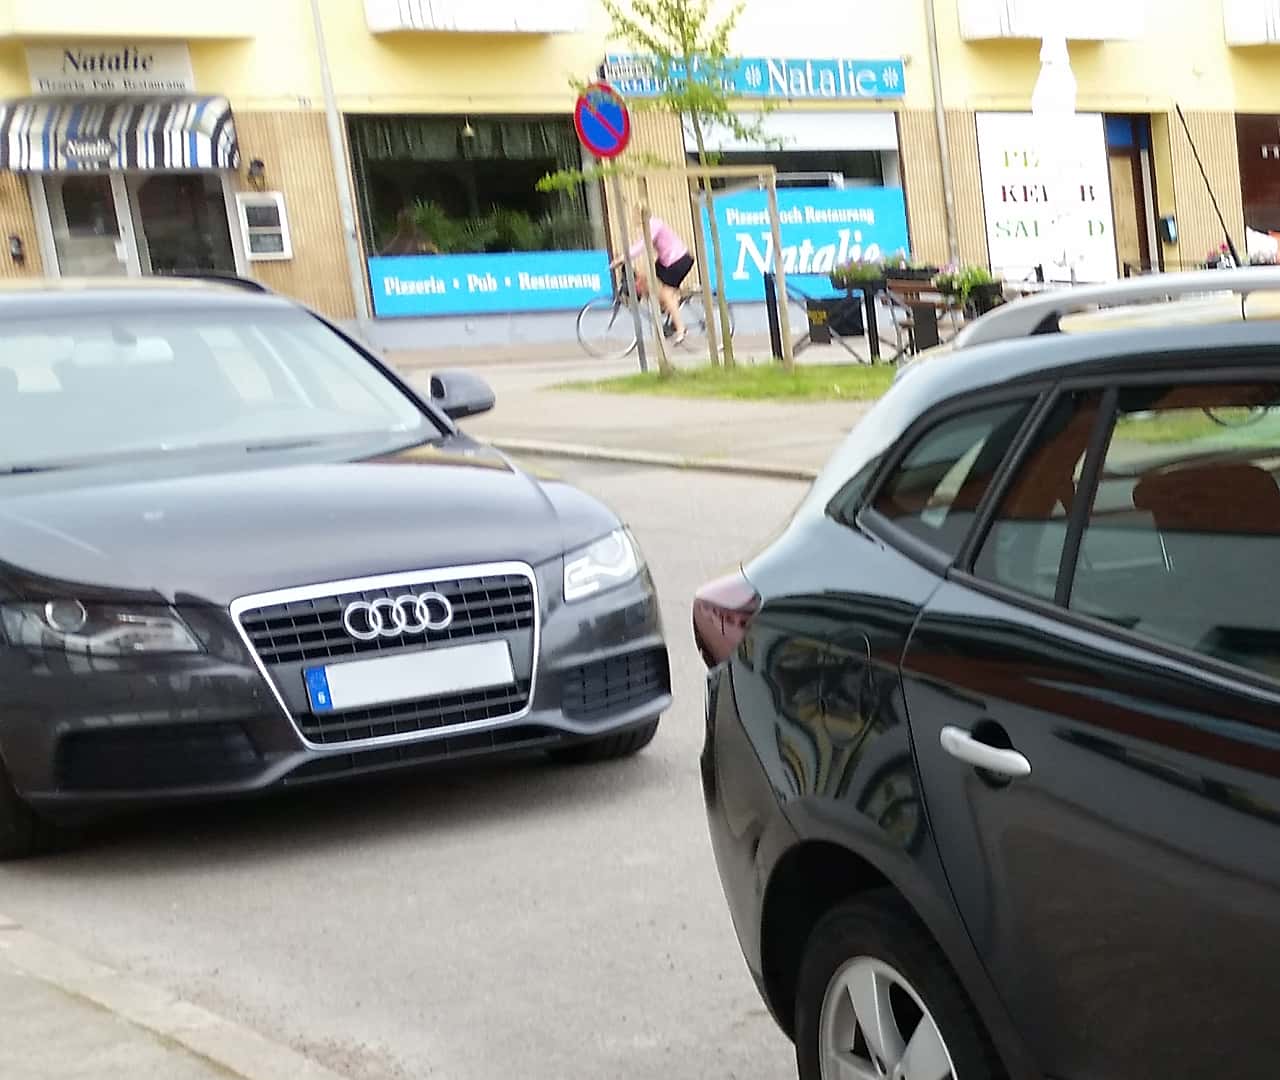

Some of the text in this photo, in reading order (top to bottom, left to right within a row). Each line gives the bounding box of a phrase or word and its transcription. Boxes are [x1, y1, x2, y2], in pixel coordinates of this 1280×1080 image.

[63, 48, 153, 72] Natalie
[765, 58, 878, 95] Natalie
[66, 138, 112, 156] Natalie
[725, 205, 876, 226] Pizzeri och Restaurang
[383, 270, 601, 296] Pizzeria Pub Restaurang
